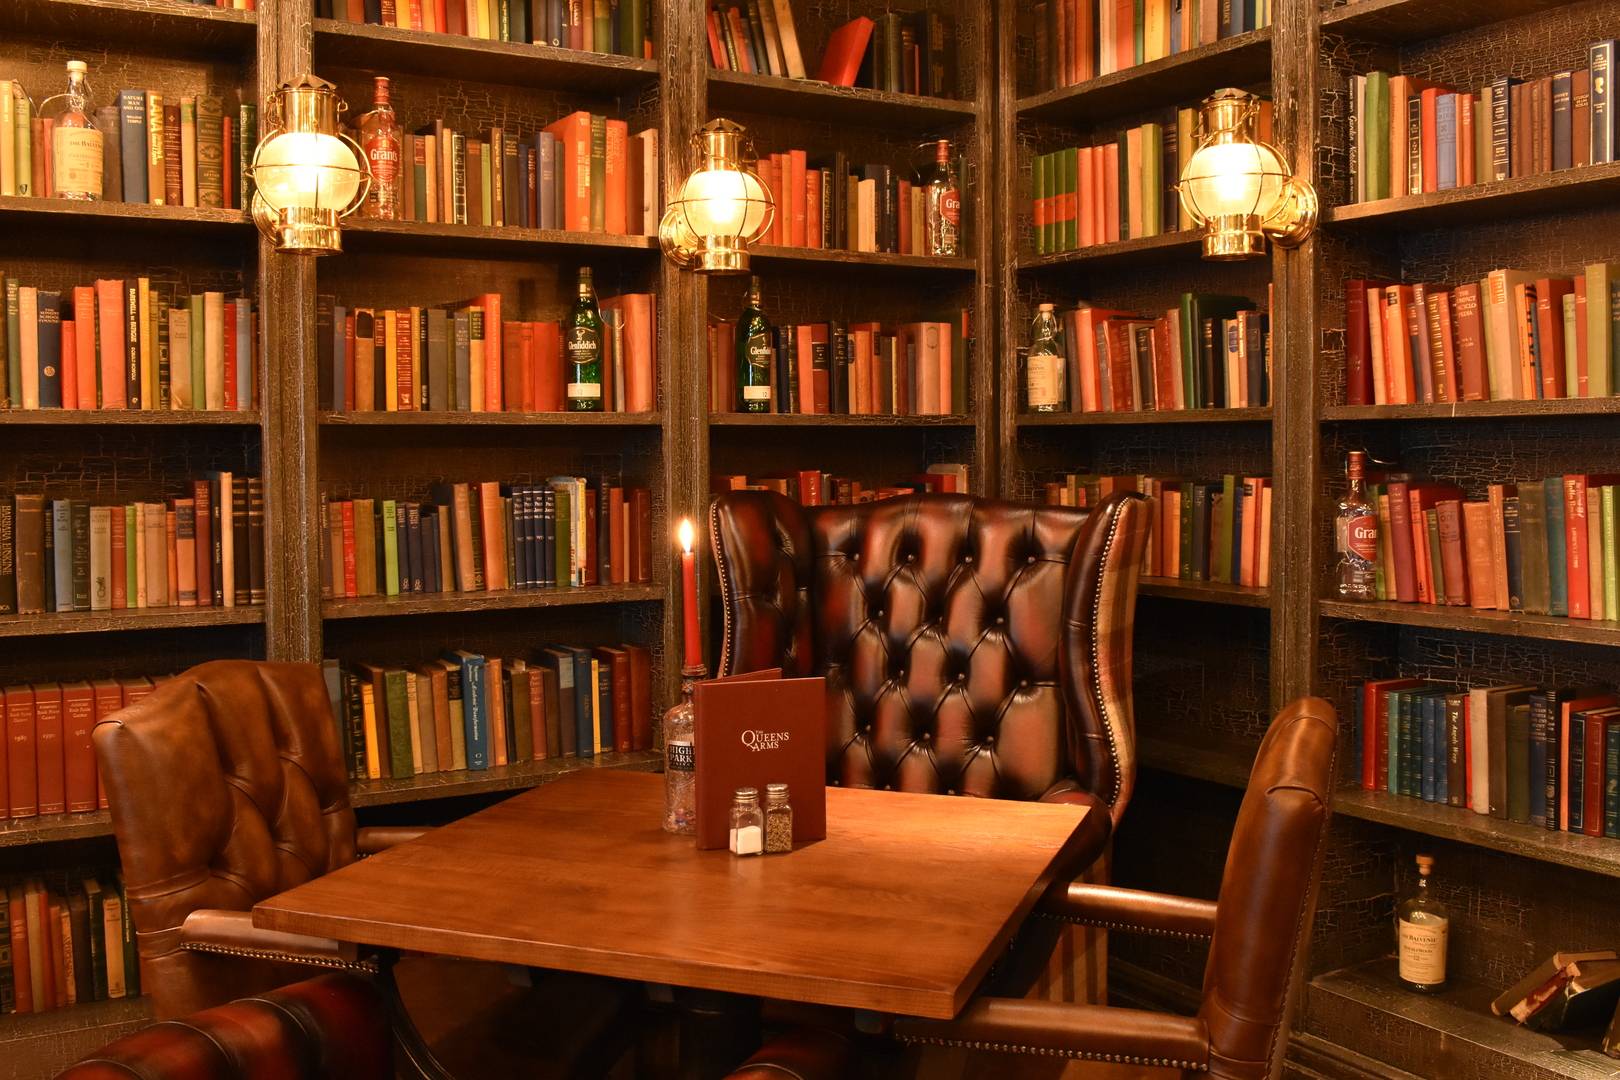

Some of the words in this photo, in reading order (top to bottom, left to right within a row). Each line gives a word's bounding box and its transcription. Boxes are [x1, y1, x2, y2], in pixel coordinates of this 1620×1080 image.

[150, 95, 163, 132] LANA
[1347, 115, 1357, 141] Garden
[1348, 144, 1358, 174] Notebook
[945, 199, 960, 210] Gra
[568, 339, 597, 350] Glenfiddich
[2, 505, 12, 541] BARBARA
[2, 543, 12, 576] ERSKINE
[741, 730, 790, 748] QUEENS
[752, 741, 779, 752] ARMS
[669, 746, 695, 755] HIGH
[669, 754, 693, 763] PARK
